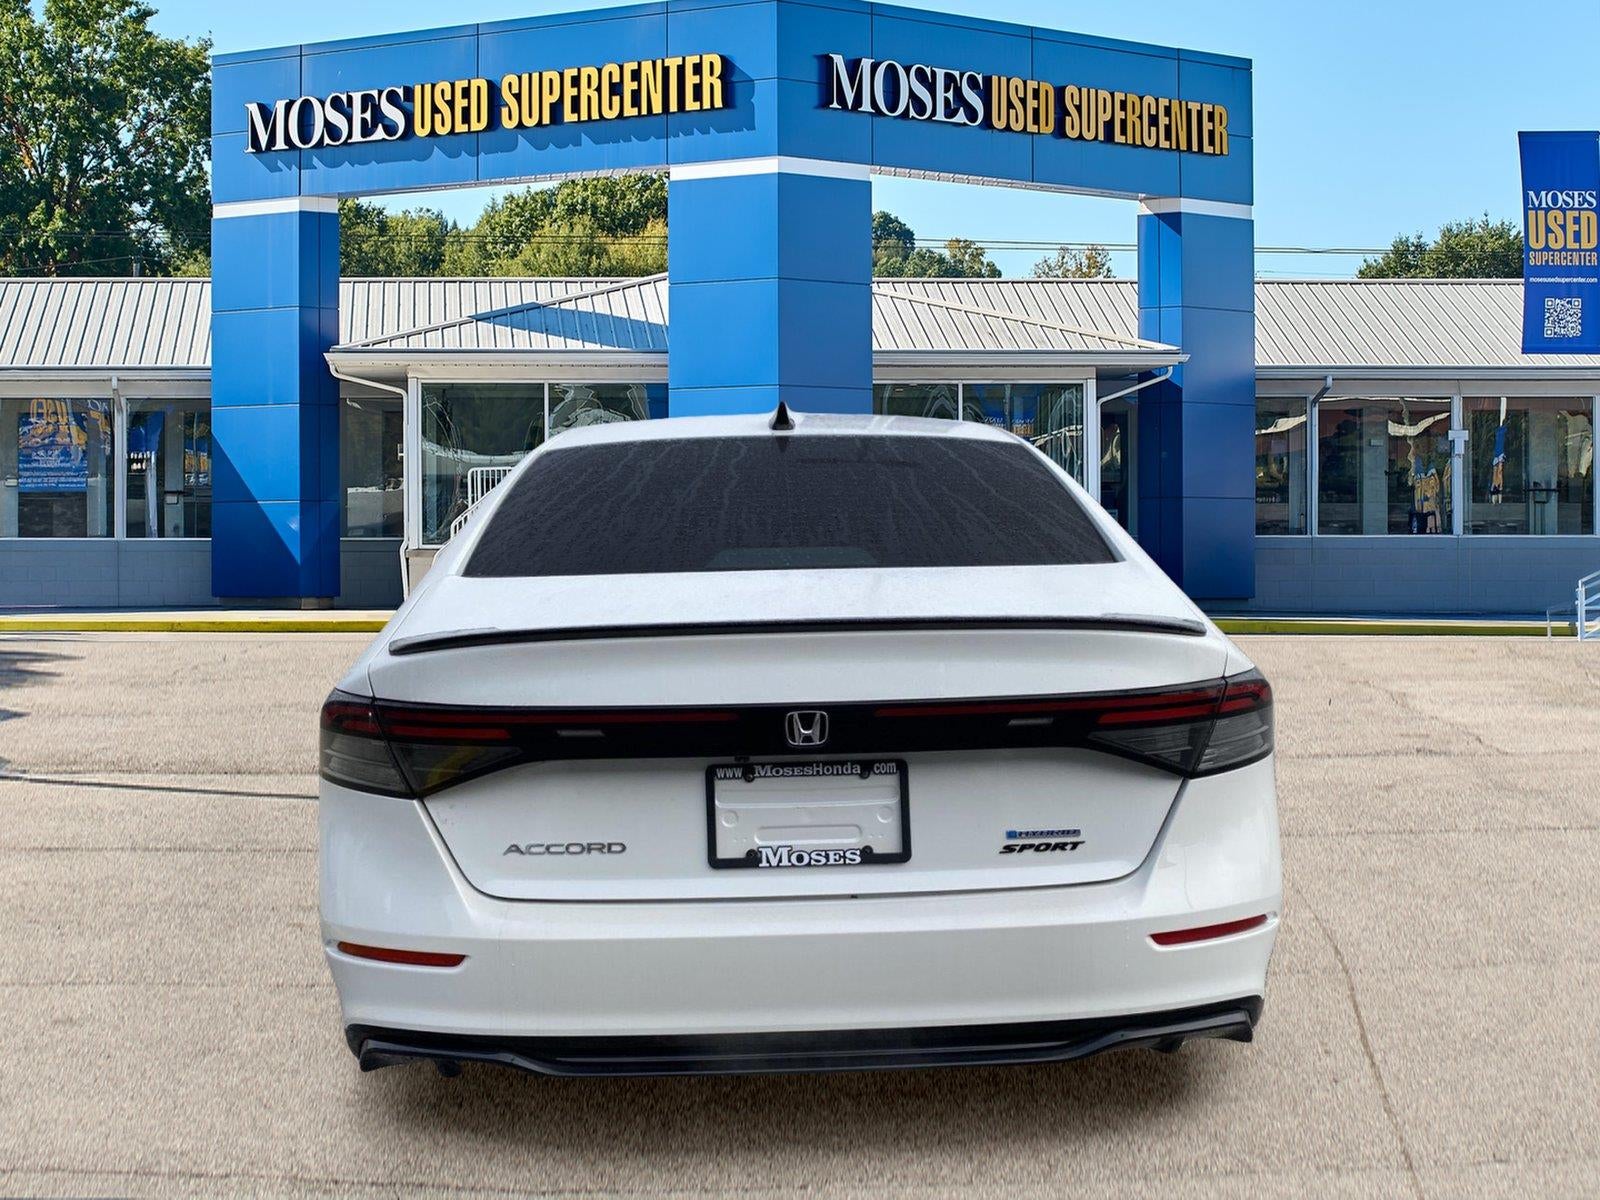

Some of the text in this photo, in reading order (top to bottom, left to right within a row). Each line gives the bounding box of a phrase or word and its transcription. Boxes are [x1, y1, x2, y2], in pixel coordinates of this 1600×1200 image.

[245, 53, 724, 154] MOSES USED SUPERCENTER
[828, 53, 1229, 155] MOSES USED SUPERCENTER
[1527, 190, 1597, 209] MOSES
[1528, 210, 1598, 250] USED
[1529, 251, 1598, 266] SUPERCENTER
[1018, 829, 1081, 838] HYBRID
[503, 842, 627, 856] ACCORD
[999, 841, 1085, 854] SPORT
[758, 847, 861, 868] MOSES
